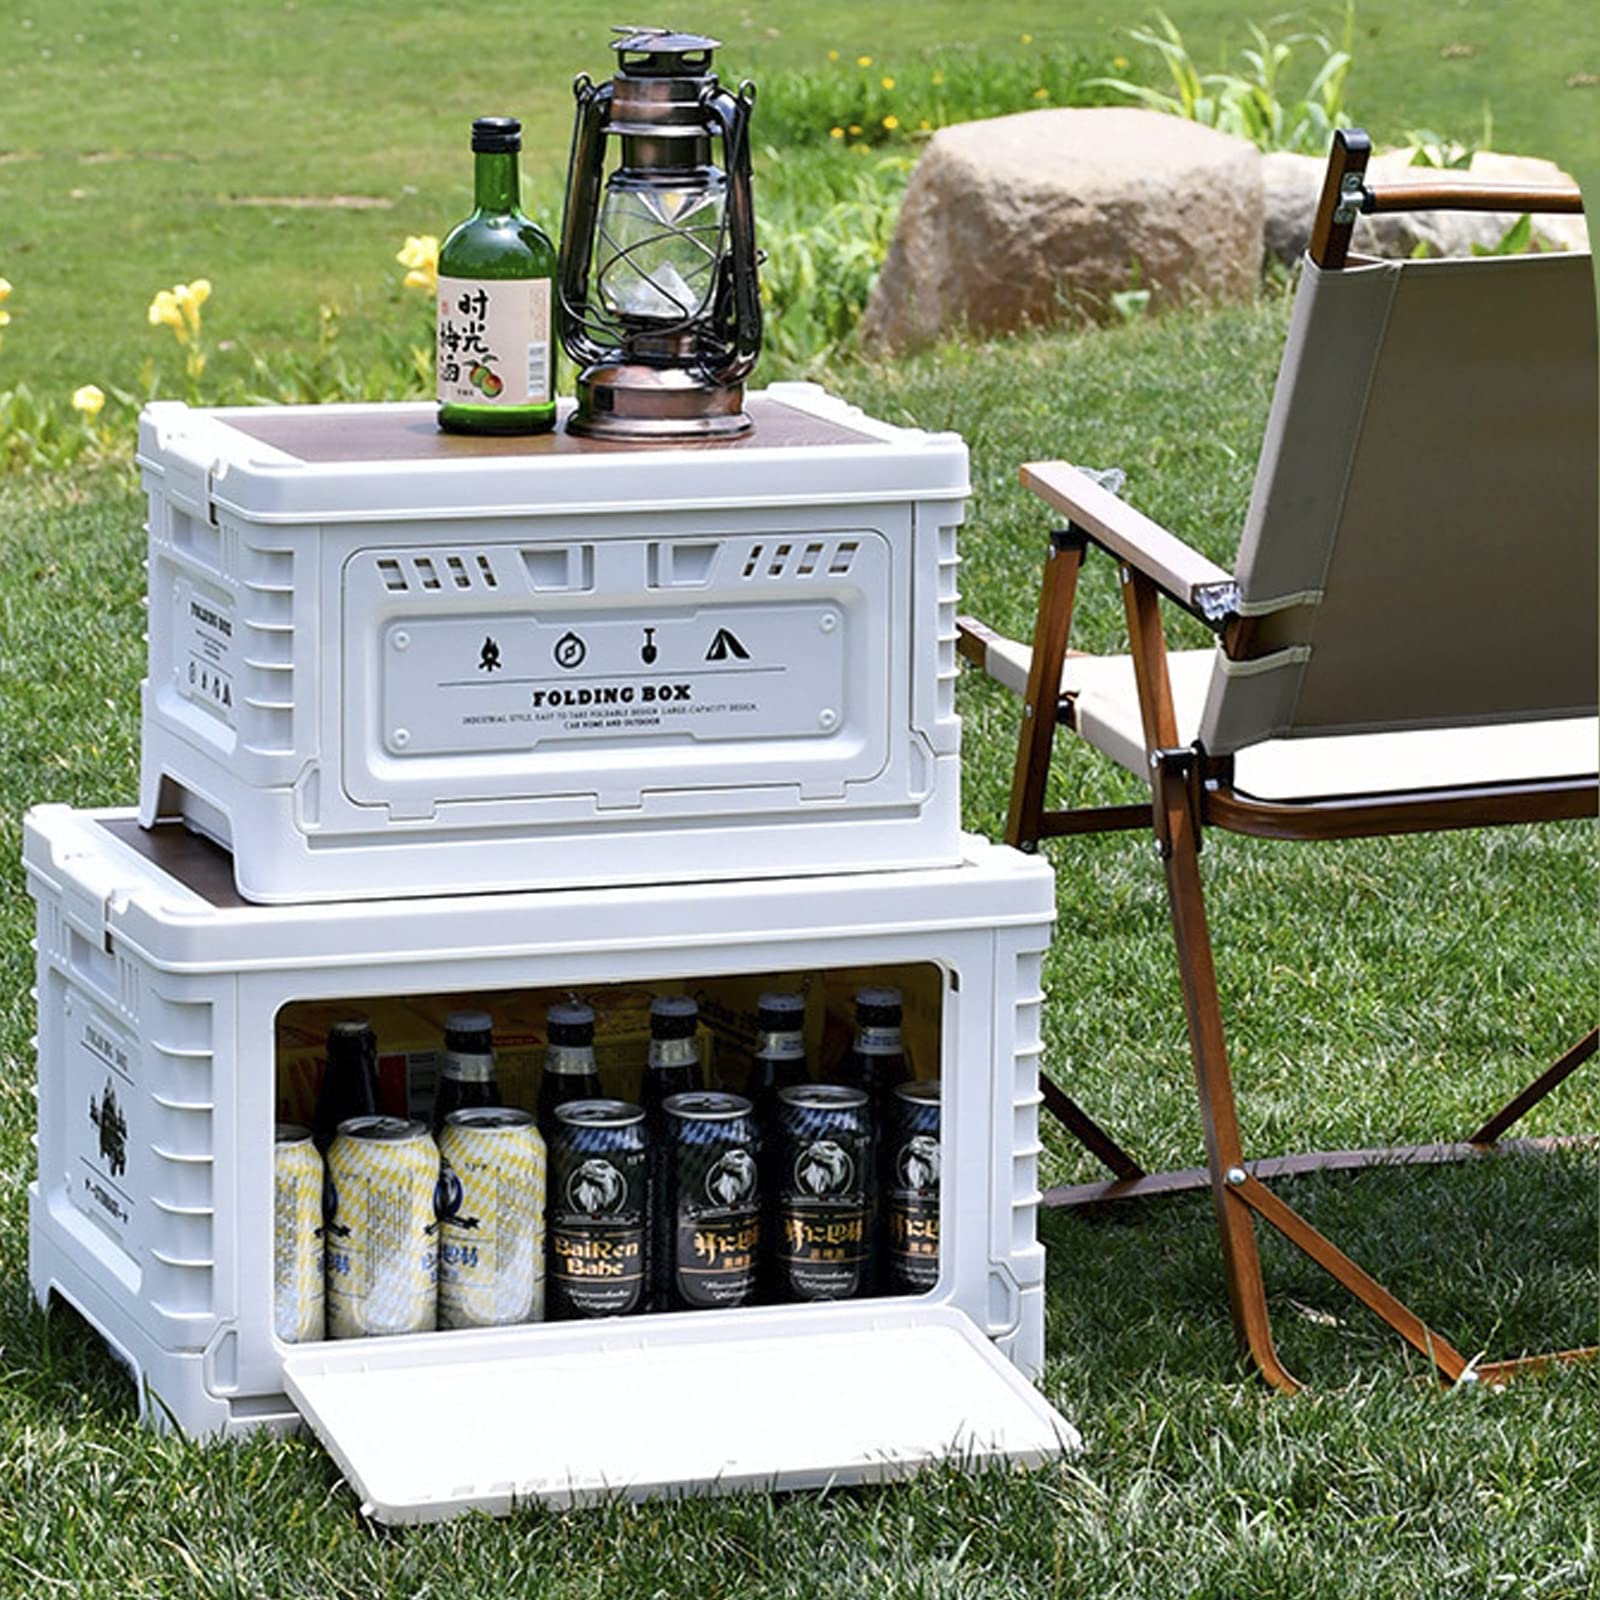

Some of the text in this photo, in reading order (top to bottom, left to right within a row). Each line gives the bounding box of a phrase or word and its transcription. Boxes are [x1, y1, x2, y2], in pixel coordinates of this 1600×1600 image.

[458, 288, 489, 354] 时光
[533, 684, 691, 707] FOLDING BOX
[605, 718, 622, 727] AND
[624, 717, 660, 727] OUTDOOR
